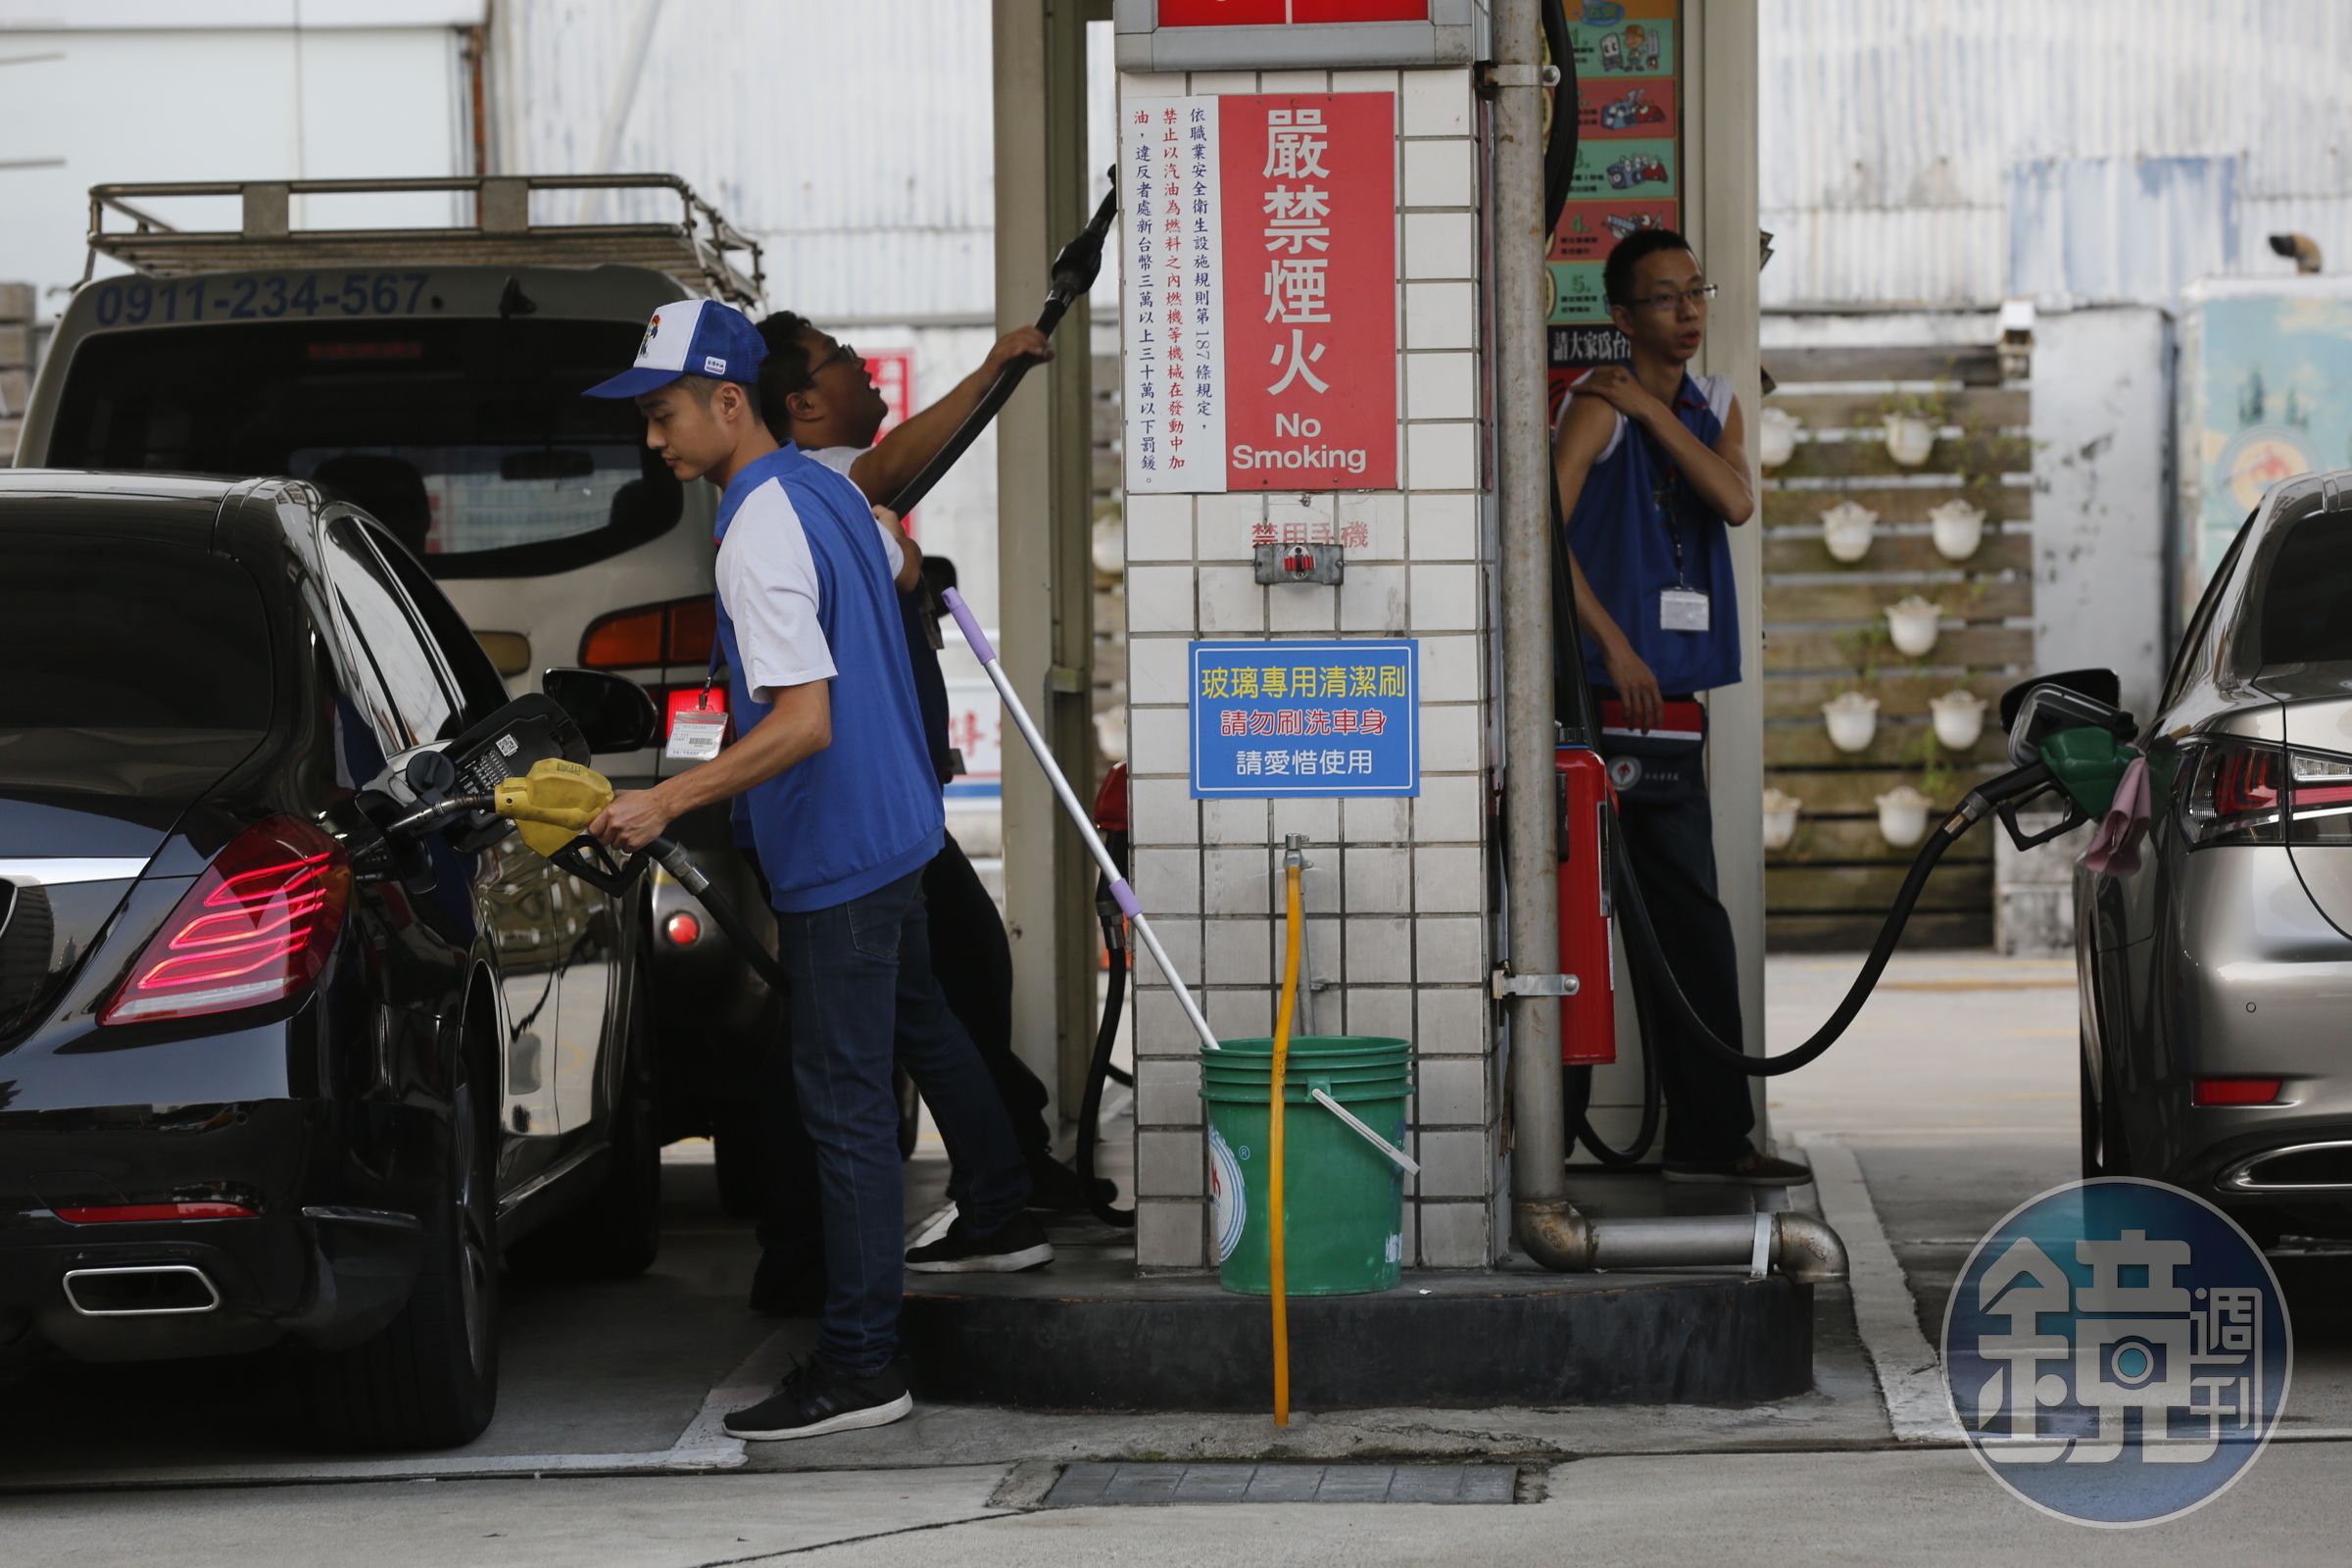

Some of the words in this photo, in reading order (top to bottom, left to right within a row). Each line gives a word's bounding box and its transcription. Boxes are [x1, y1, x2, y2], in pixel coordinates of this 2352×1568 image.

[1263, 109, 1331, 396] 嚴禁煙火
[97, 273, 430, 325] 0911-234-567
[1275, 413, 1322, 438] No
[1232, 444, 1366, 474] Smoking
[1201, 665, 1406, 699] 玻璃專用清潔刷
[1220, 709, 1387, 736] 請勿刷洗車身
[1236, 749, 1373, 775] 請愛惜使用
